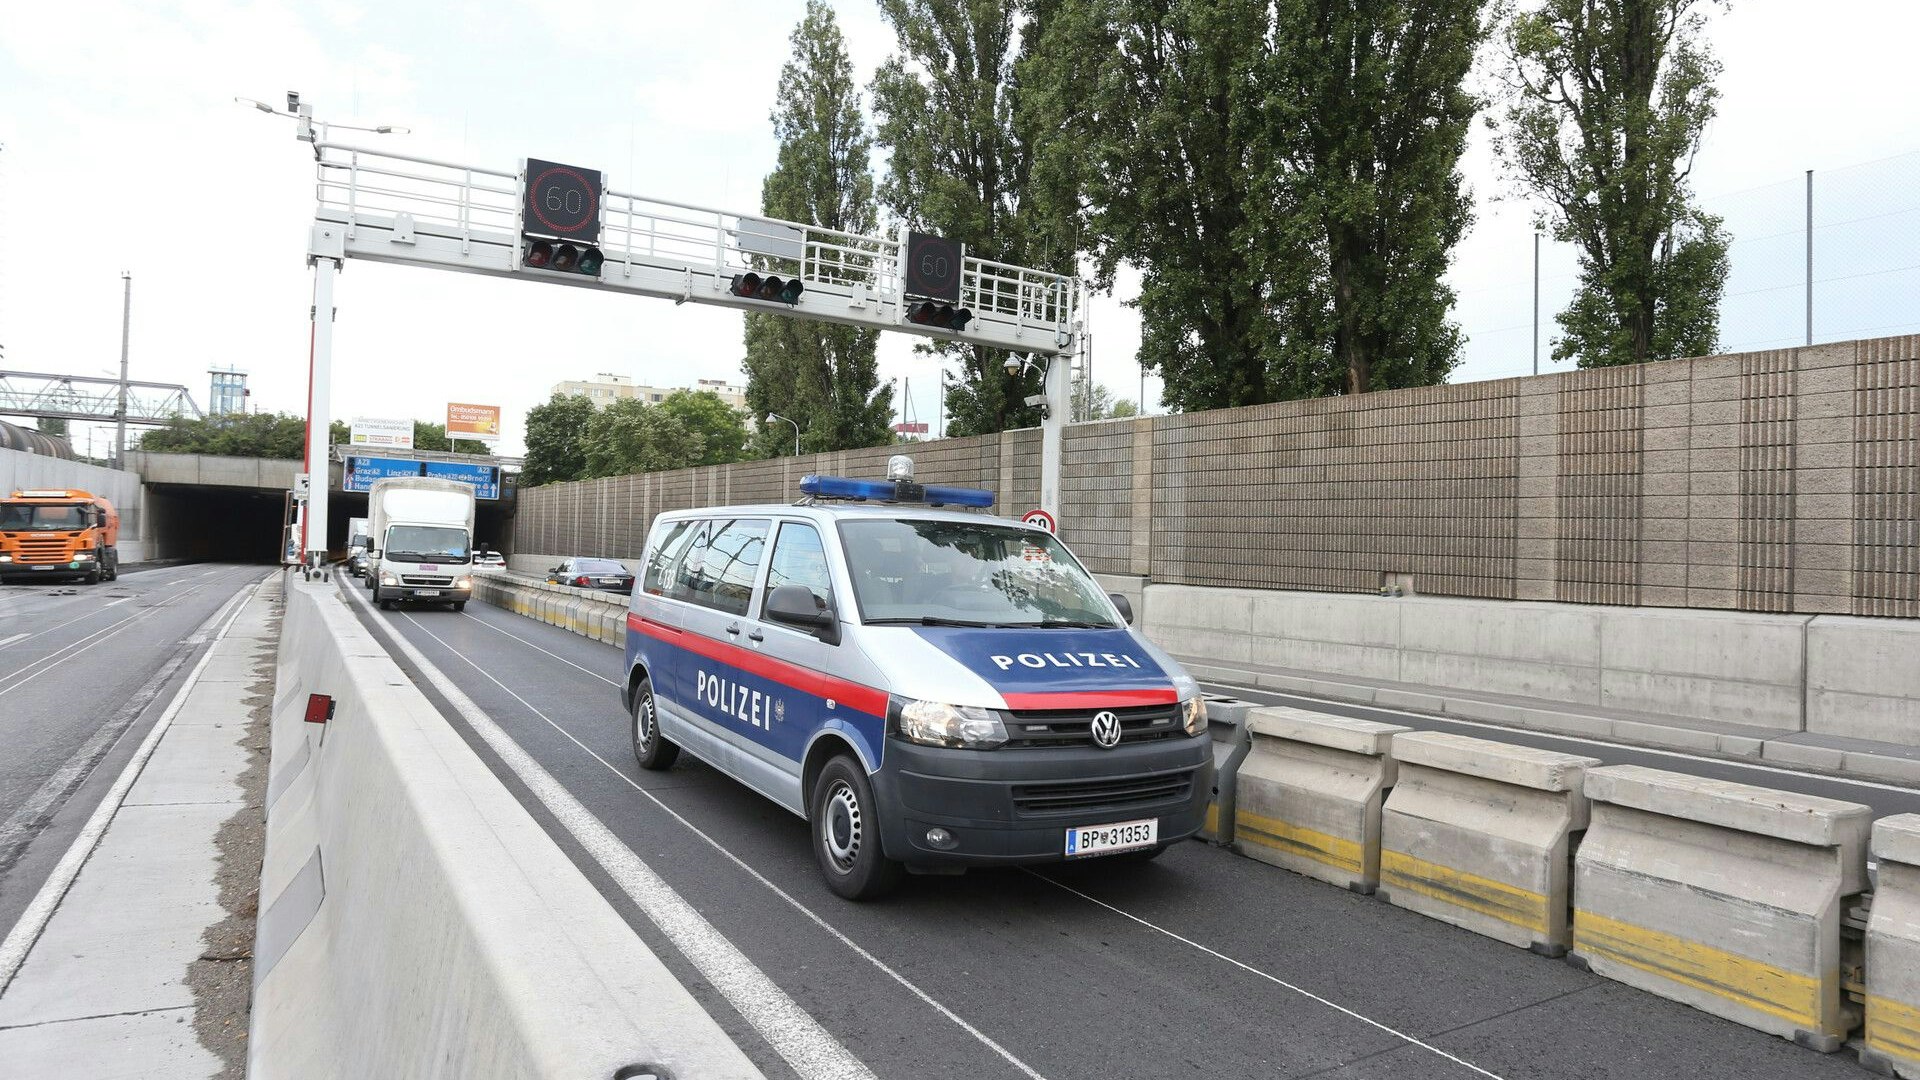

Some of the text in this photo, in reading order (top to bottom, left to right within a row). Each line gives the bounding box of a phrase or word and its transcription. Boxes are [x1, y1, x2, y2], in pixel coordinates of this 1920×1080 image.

[546, 186, 582, 215] 60
[922, 254, 948, 278] 60
[450, 405, 495, 415] Ombudsmann
[355, 467, 371, 475] Graz
[387, 469, 401, 477] Linz
[427, 471, 447, 480] Praha
[467, 474, 482, 482] Brno
[991, 652, 1141, 671] POLIZEI
[697, 669, 771, 731] POLIZEI
[1081, 824, 1150, 849] BP 31353
